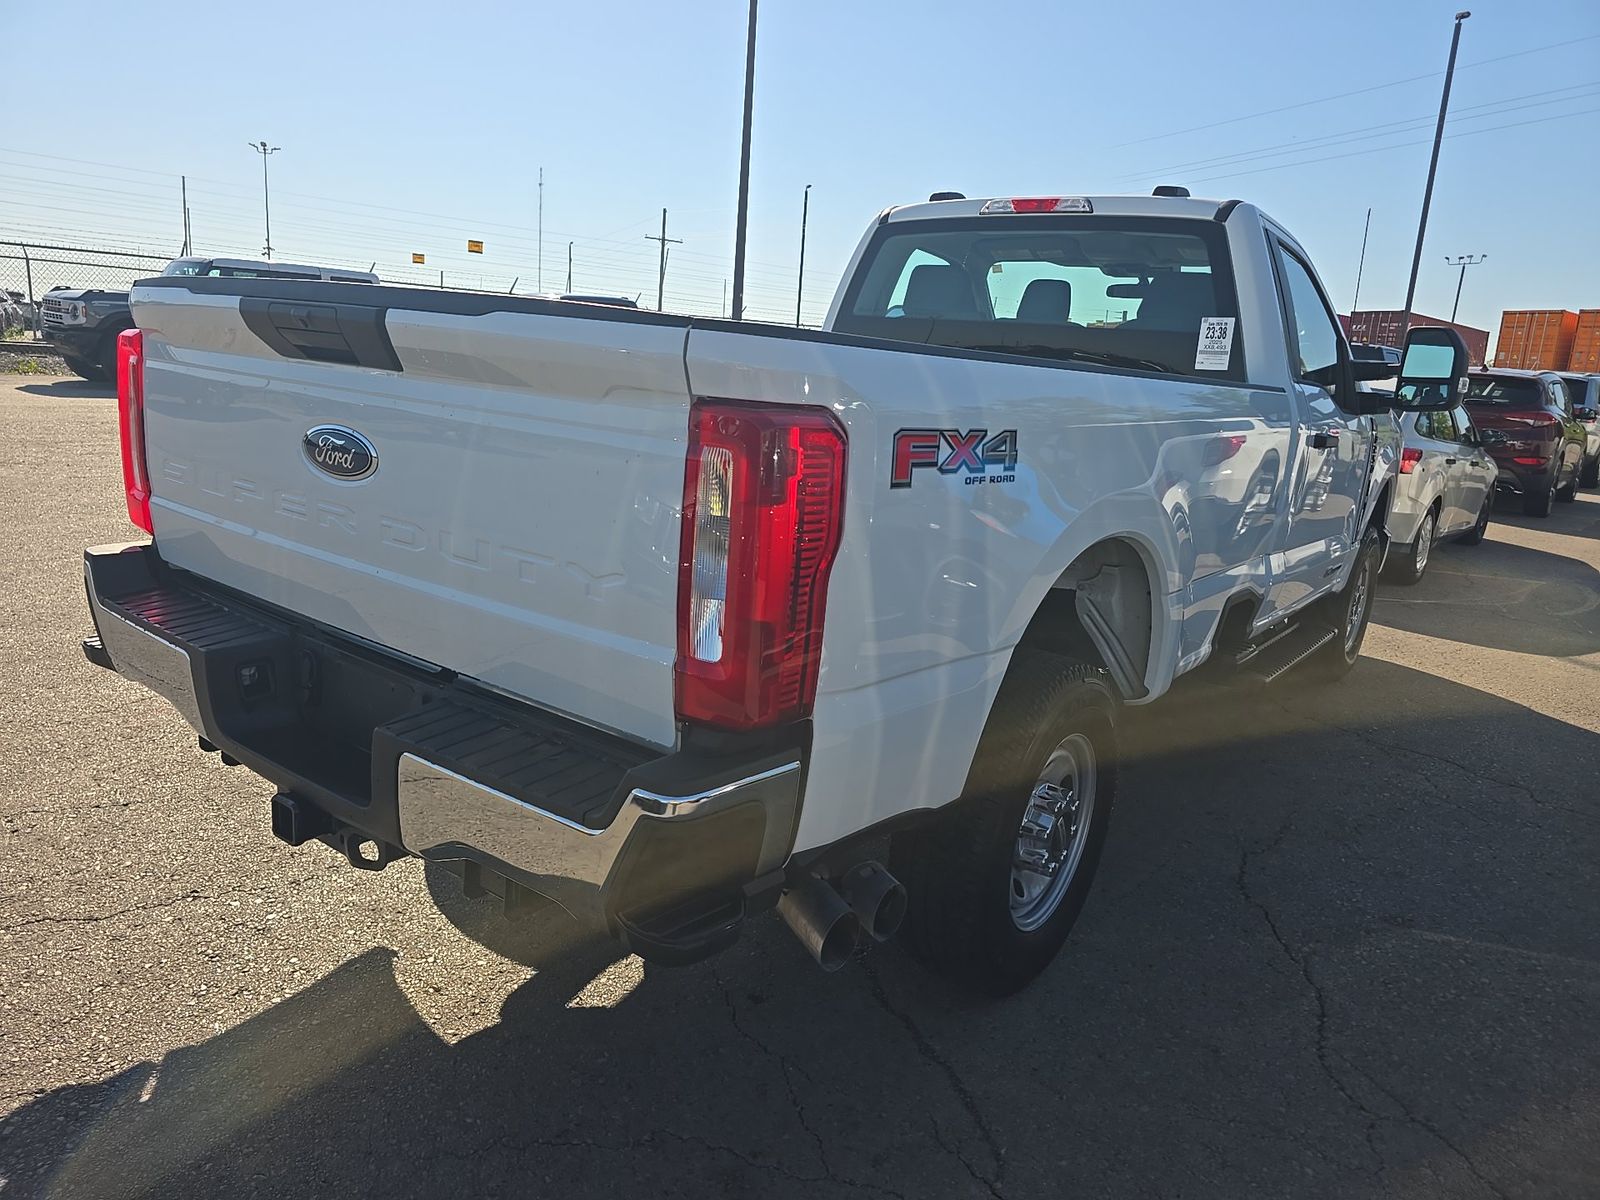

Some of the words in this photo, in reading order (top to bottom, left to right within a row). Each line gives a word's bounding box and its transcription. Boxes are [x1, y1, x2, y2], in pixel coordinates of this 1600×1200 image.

[1205, 326, 1228, 340] 23:38
[315, 434, 356, 469] Ford
[890, 427, 1018, 489] FX4
[965, 475, 986, 485] OFF
[989, 474, 1015, 484] ROAD
[379, 514, 627, 602] DUTY
